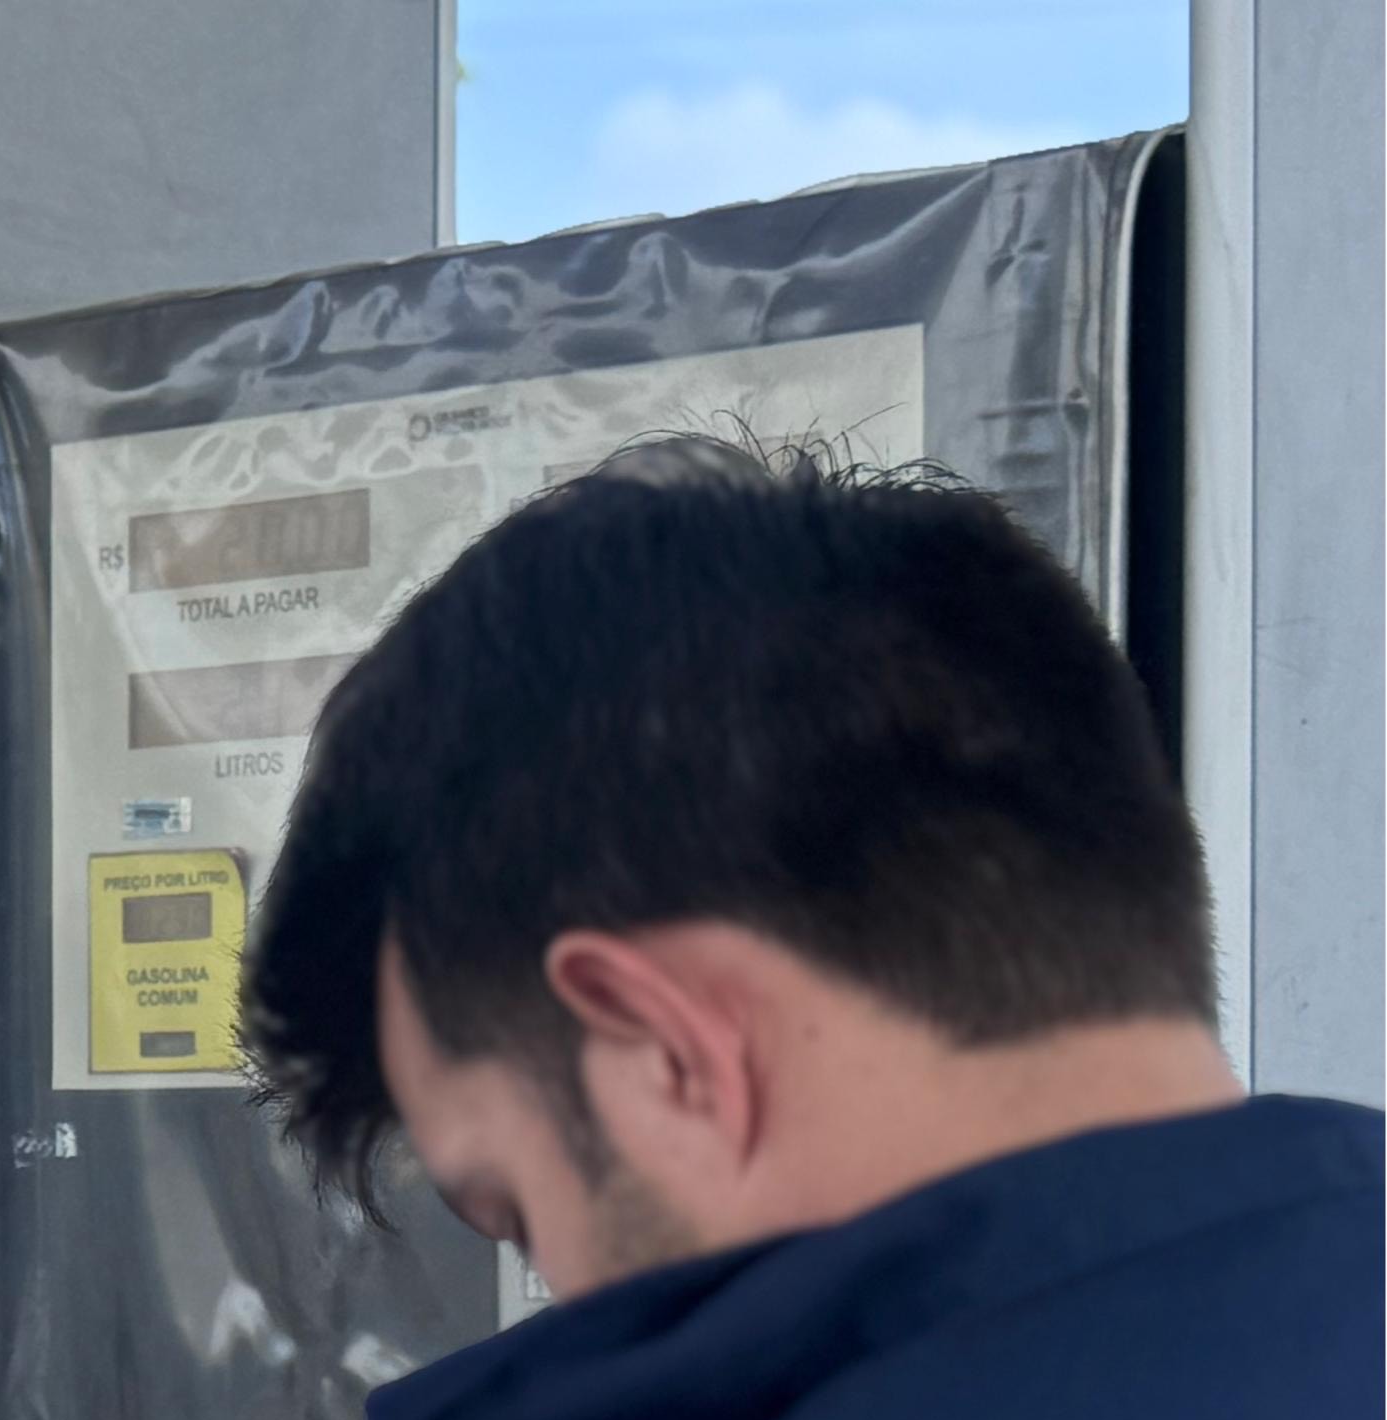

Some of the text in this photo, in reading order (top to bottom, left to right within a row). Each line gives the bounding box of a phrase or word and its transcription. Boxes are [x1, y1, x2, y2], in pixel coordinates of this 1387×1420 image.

[99, 545, 124, 571] R$
[178, 587, 319, 622] TOTAL A PAGAR
[215, 751, 284, 778] LITROS
[103, 870, 230, 891] PREÇO POR LITRO
[126, 966, 209, 985] GASOLINA
[137, 989, 197, 1006] COMUM
